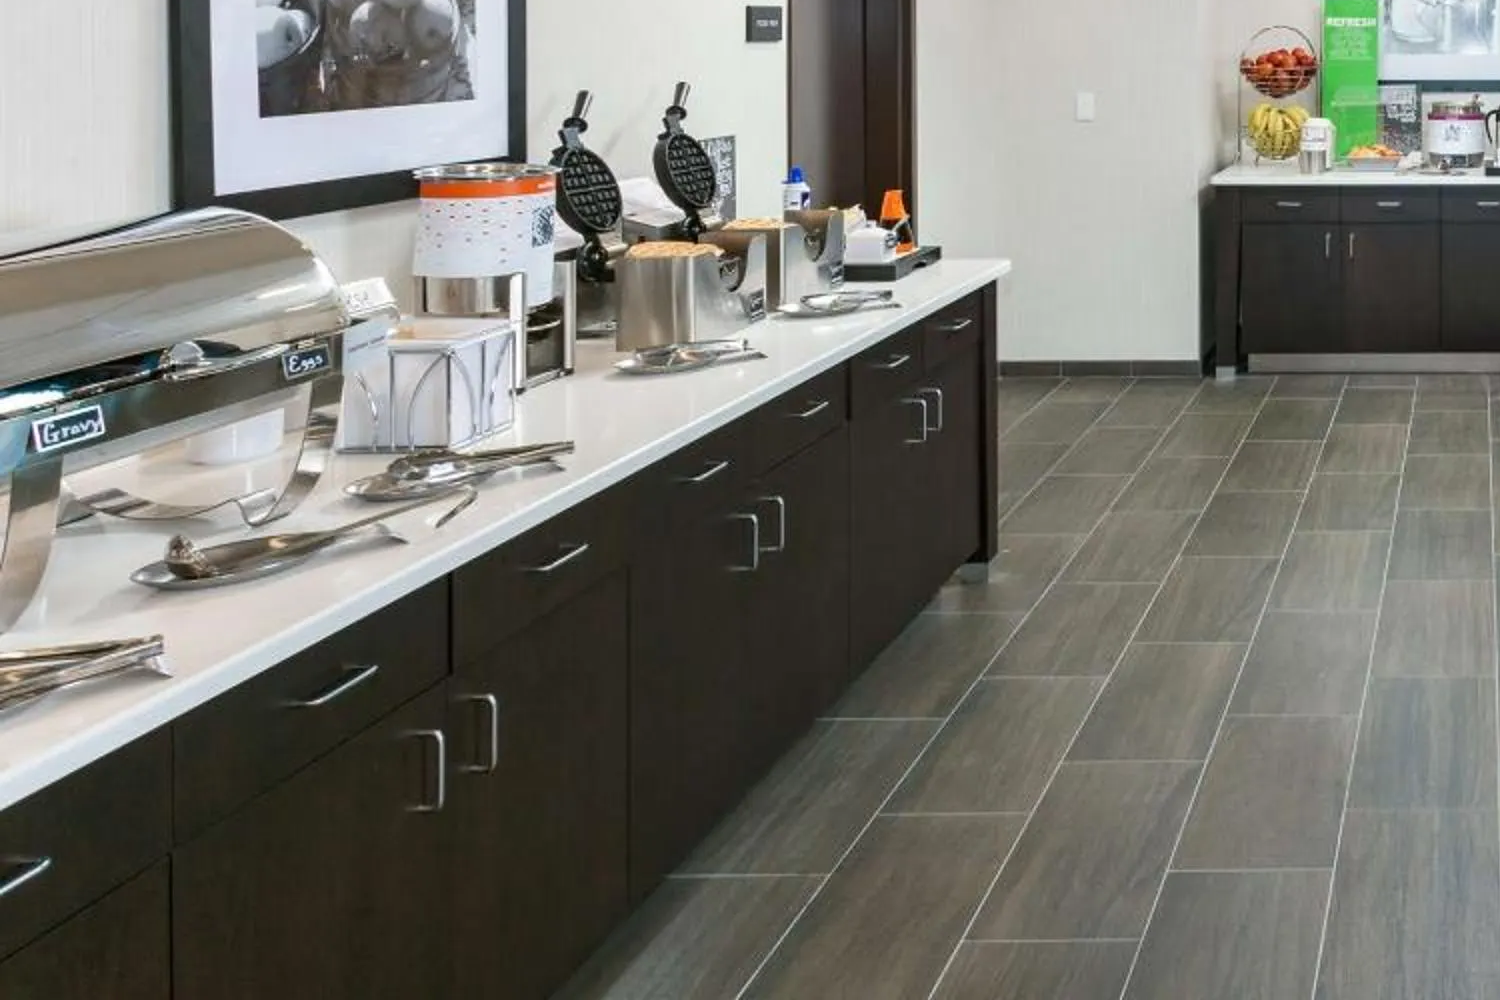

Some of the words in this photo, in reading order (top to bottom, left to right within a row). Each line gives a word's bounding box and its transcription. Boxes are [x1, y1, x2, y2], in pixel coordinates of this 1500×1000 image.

[1327, 16, 1377, 28] REFRESH
[289, 355, 323, 372] Eggs
[43, 419, 101, 444] Gravy
